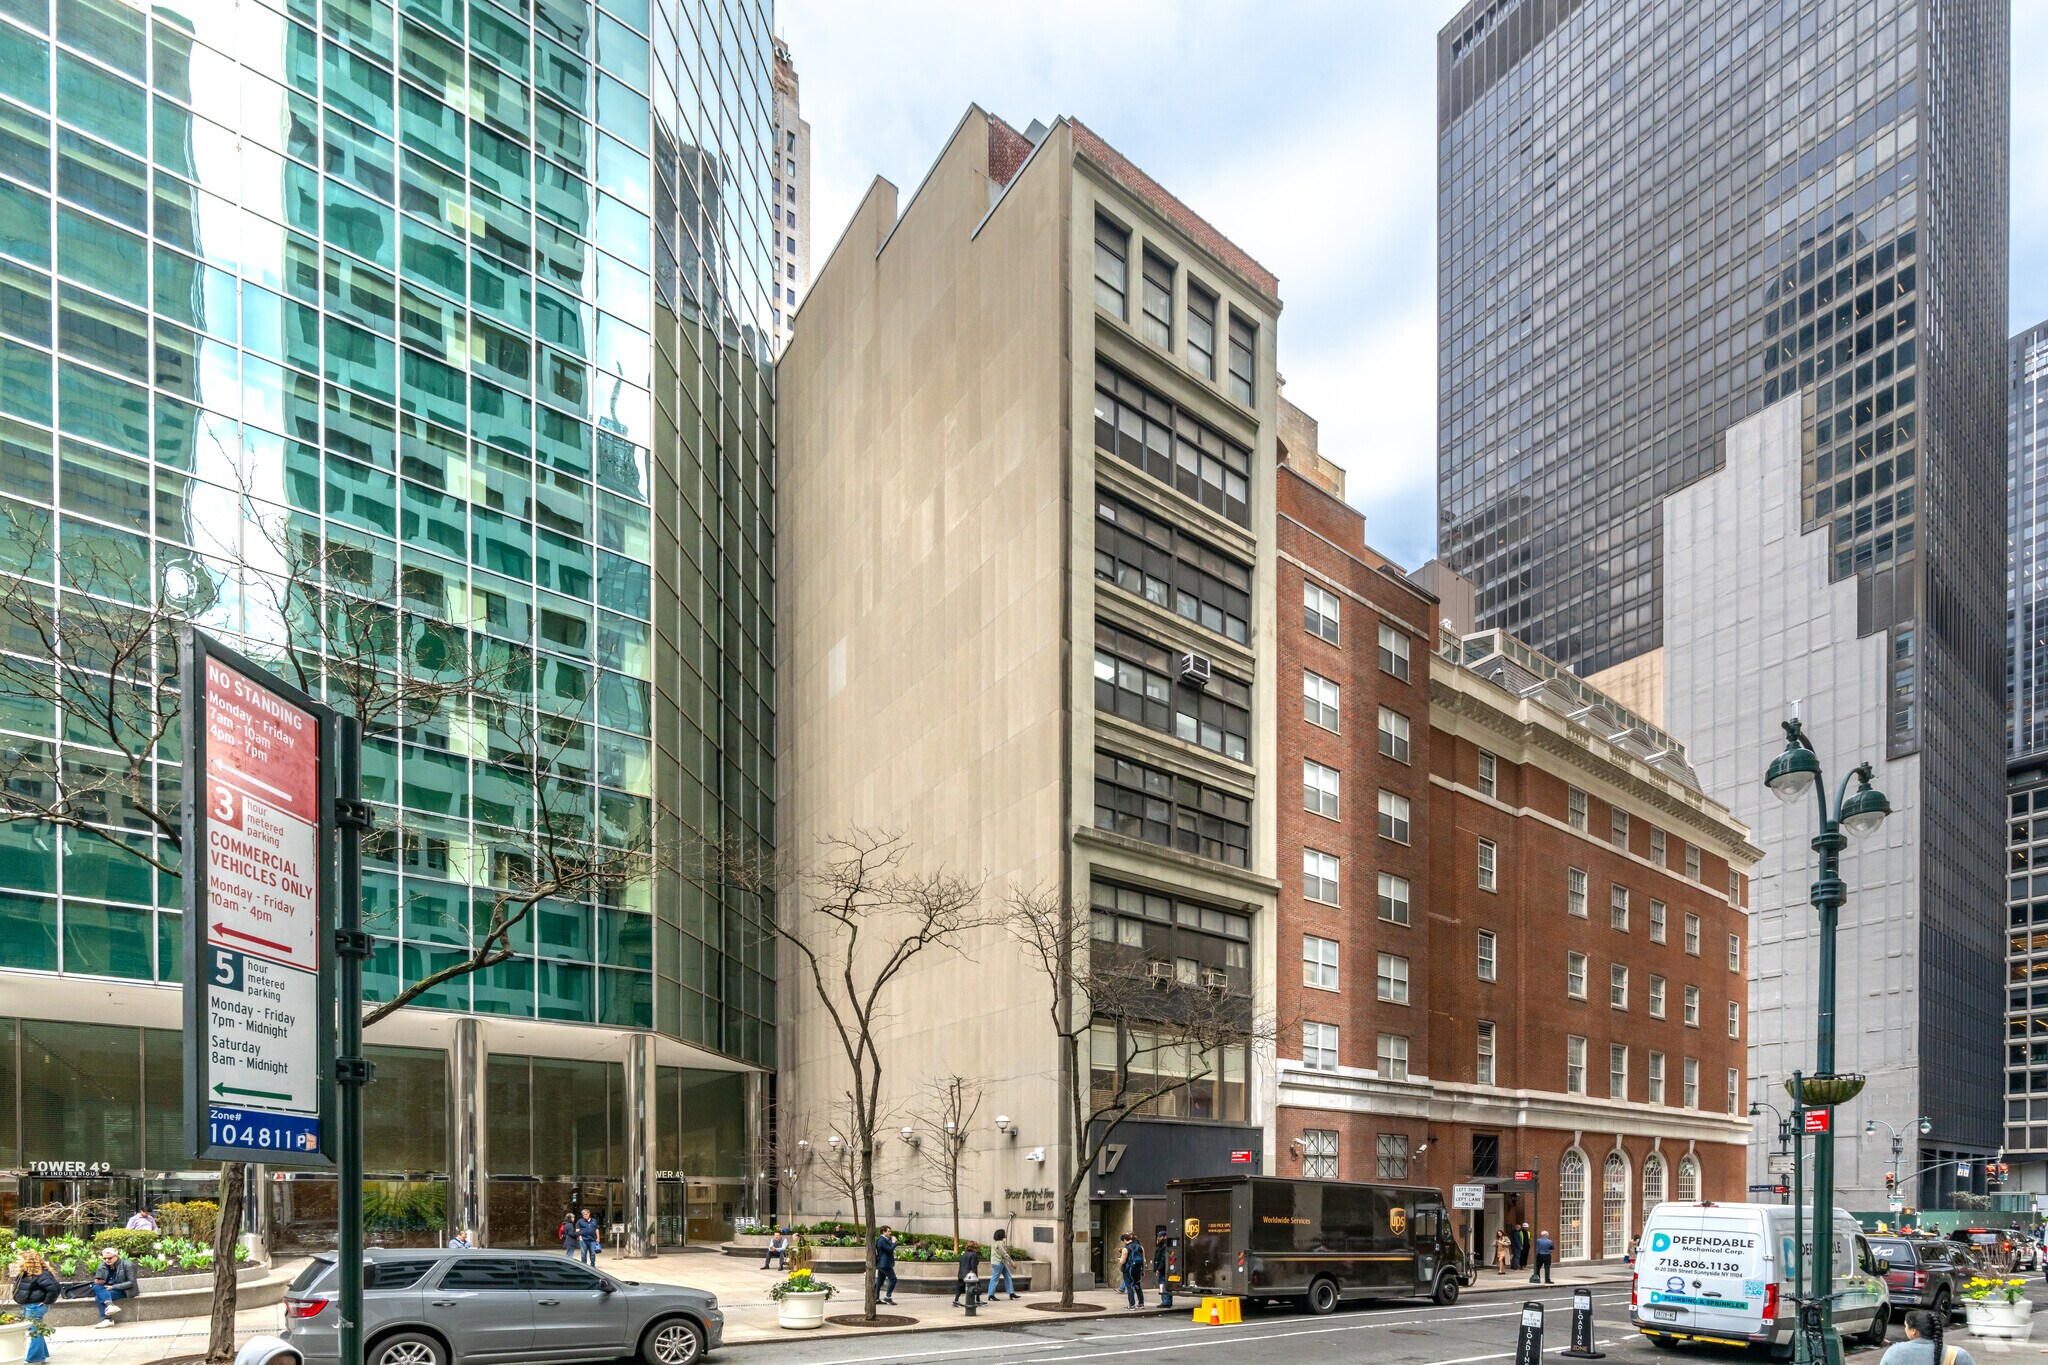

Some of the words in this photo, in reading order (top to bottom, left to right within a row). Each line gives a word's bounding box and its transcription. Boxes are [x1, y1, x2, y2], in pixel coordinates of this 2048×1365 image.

[209, 664, 230, 689] NO
[235, 681, 302, 730] STANDING
[209, 690, 252, 726] Monday
[264, 720, 294, 748] Friday
[210, 706, 234, 730] 7am
[244, 726, 270, 749] 10am
[210, 723, 235, 748] 4pm
[245, 744, 267, 764] 7pm
[214, 786, 234, 822] 3
[247, 799, 267, 817] hour
[247, 814, 284, 837] metered
[247, 827, 280, 848] parking
[210, 830, 299, 878] COMMERCIAL
[210, 849, 277, 888] VEHICLES
[282, 876, 313, 900] ONLY
[210, 875, 252, 902] Monday
[264, 894, 295, 918] Friday
[211, 892, 239, 912] 10am
[250, 906, 272, 922] 4pm
[215, 950, 234, 985] 5
[248, 960, 268, 974] hour
[248, 972, 285, 990] metered
[248, 986, 280, 1003] parking
[211, 996, 254, 1018] Monday
[264, 1008, 295, 1027] Friday
[212, 1012, 235, 1029] 7pm
[246, 1020, 288, 1039] Midnight
[212, 1035, 261, 1056] Saturday
[212, 1052, 236, 1066] 8am
[246, 1057, 288, 1075] Midnight
[210, 1110, 242, 1121] Zone#
[210, 1123, 291, 1149] 104811
[29, 1161, 86, 1172] TOWER
[89, 1162, 110, 1172] 49
[1098, 1144, 1127, 1175] 17
[675, 1171, 684, 1179] 49
[1186, 1224, 1198, 1236] ups
[1262, 1216, 1290, 1224] Worldwide
[1291, 1216, 1311, 1224] Services
[1392, 1216, 1405, 1231] ups
[1673, 1236, 1755, 1248] DEPENDABLE
[1682, 1246, 1723, 1254] Mechanical
[1724, 1248, 1745, 1256] Corp.
[1659, 1258, 1739, 1272] 718.806.1130
[1664, 1295, 1697, 1304] PLUMBING
[1706, 1300, 1745, 1309] SPRINKLER
